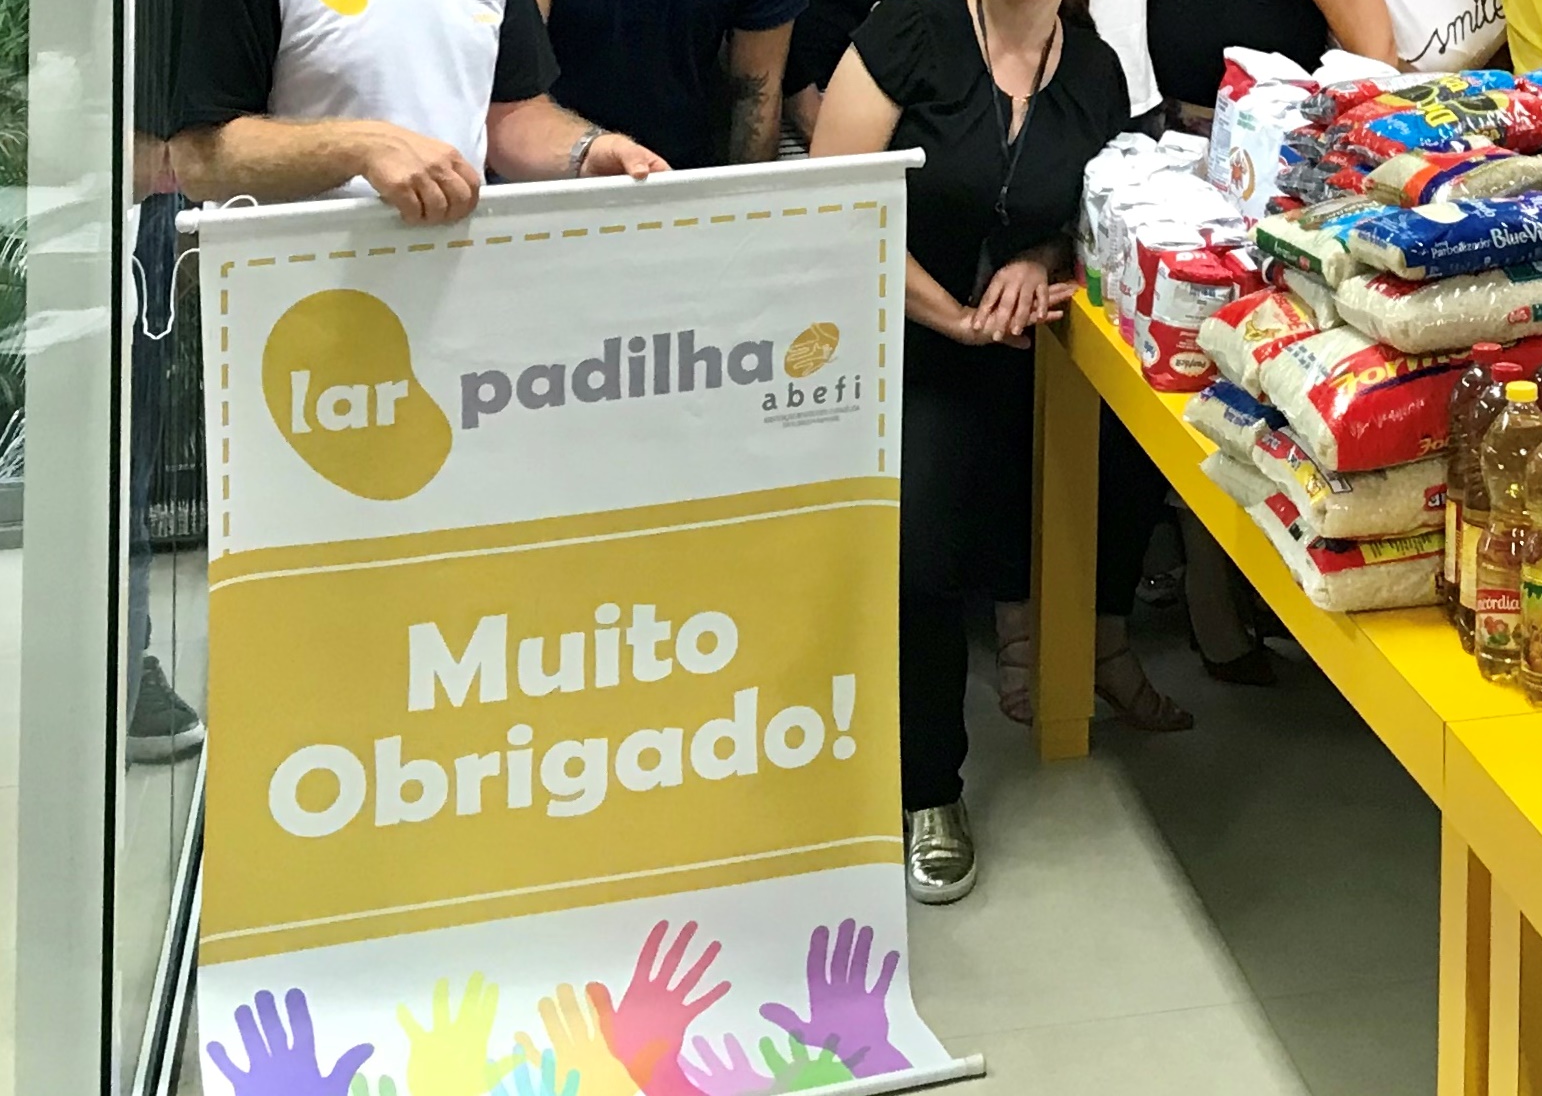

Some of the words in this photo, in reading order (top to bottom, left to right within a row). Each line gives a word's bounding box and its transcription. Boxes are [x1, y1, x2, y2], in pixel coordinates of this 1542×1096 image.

[290, 369, 408, 435] lar
[460, 330, 774, 429] padilha
[762, 374, 861, 411] abefi
[407, 603, 740, 712] Muito
[268, 674, 857, 838] Obrigado!
